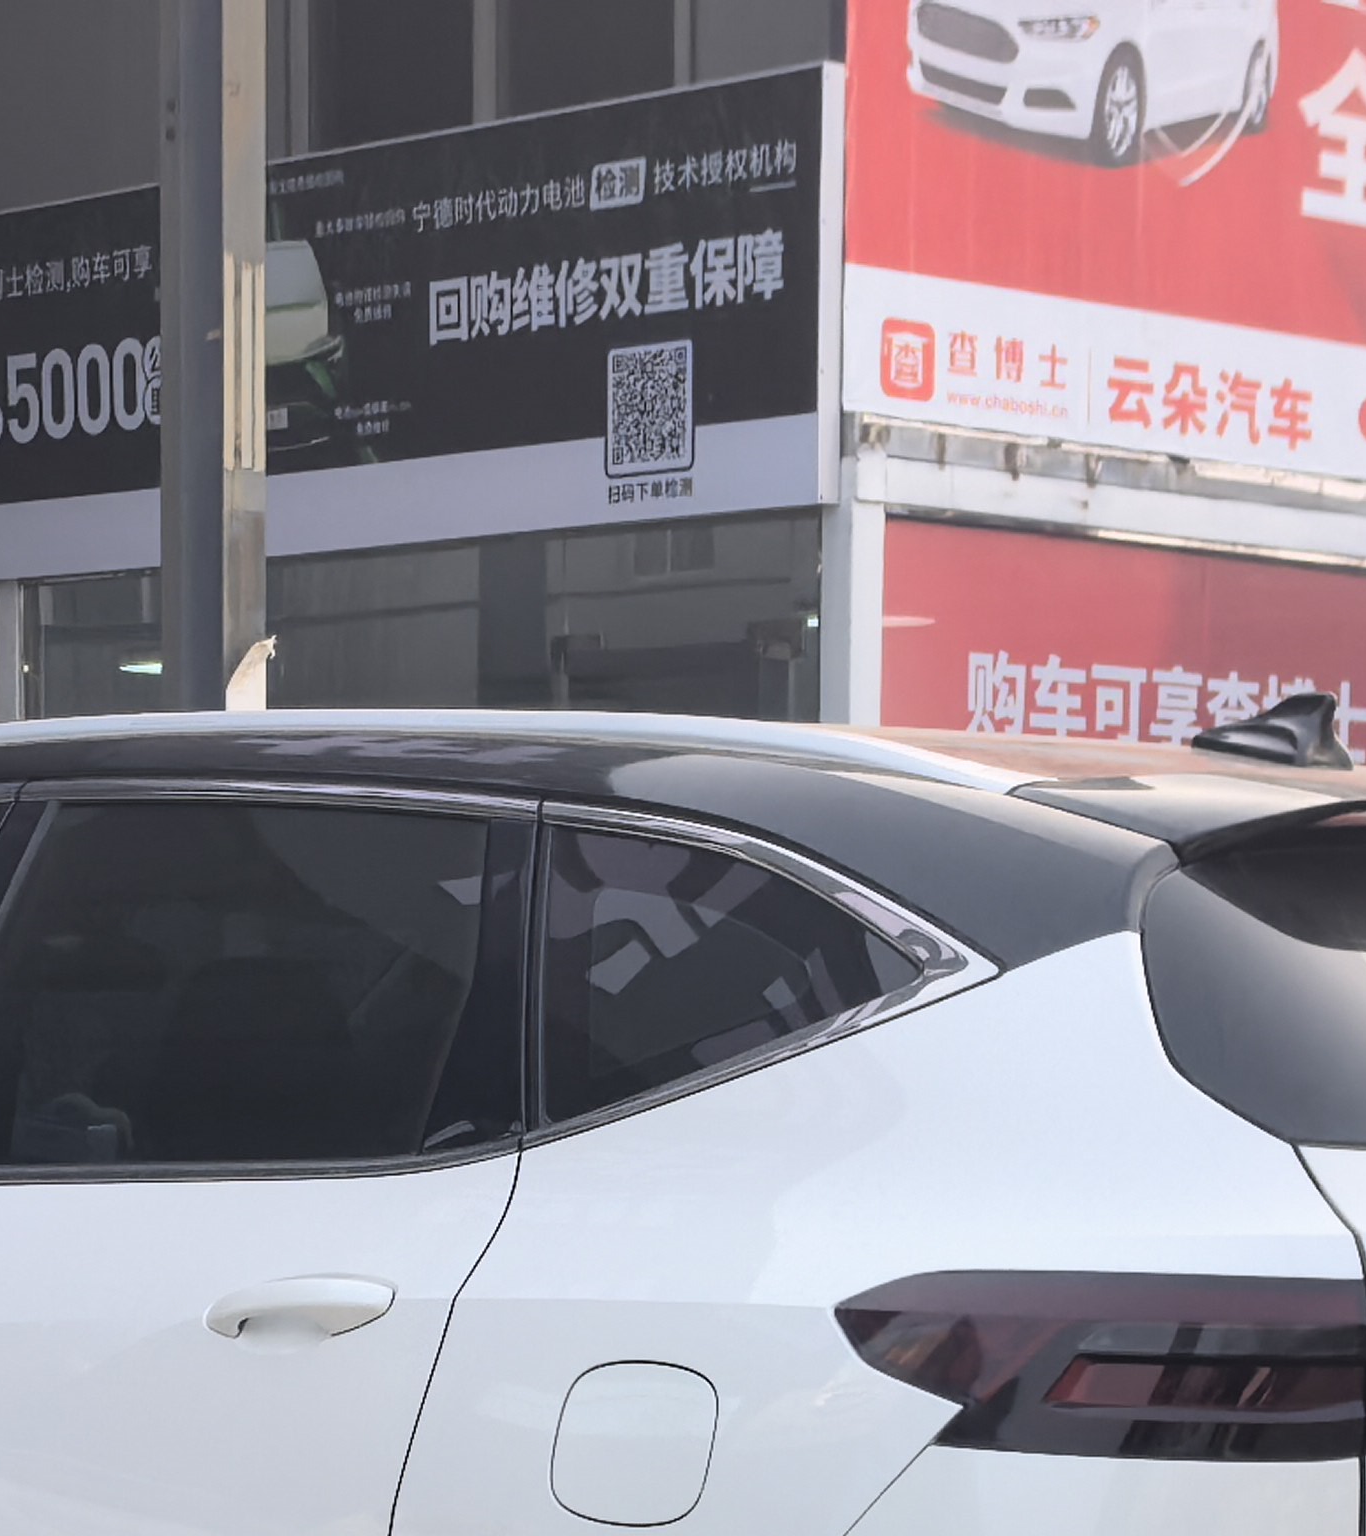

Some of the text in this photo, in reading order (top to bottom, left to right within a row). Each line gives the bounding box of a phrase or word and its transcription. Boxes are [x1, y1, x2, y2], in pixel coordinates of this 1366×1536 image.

[412, 174, 585, 232] 宁德时代动力电池
[653, 138, 797, 195] 技术授权机构
[429, 228, 785, 346] 回购维修双重保障
[947, 331, 1313, 451] 查博士 云朵汽车
